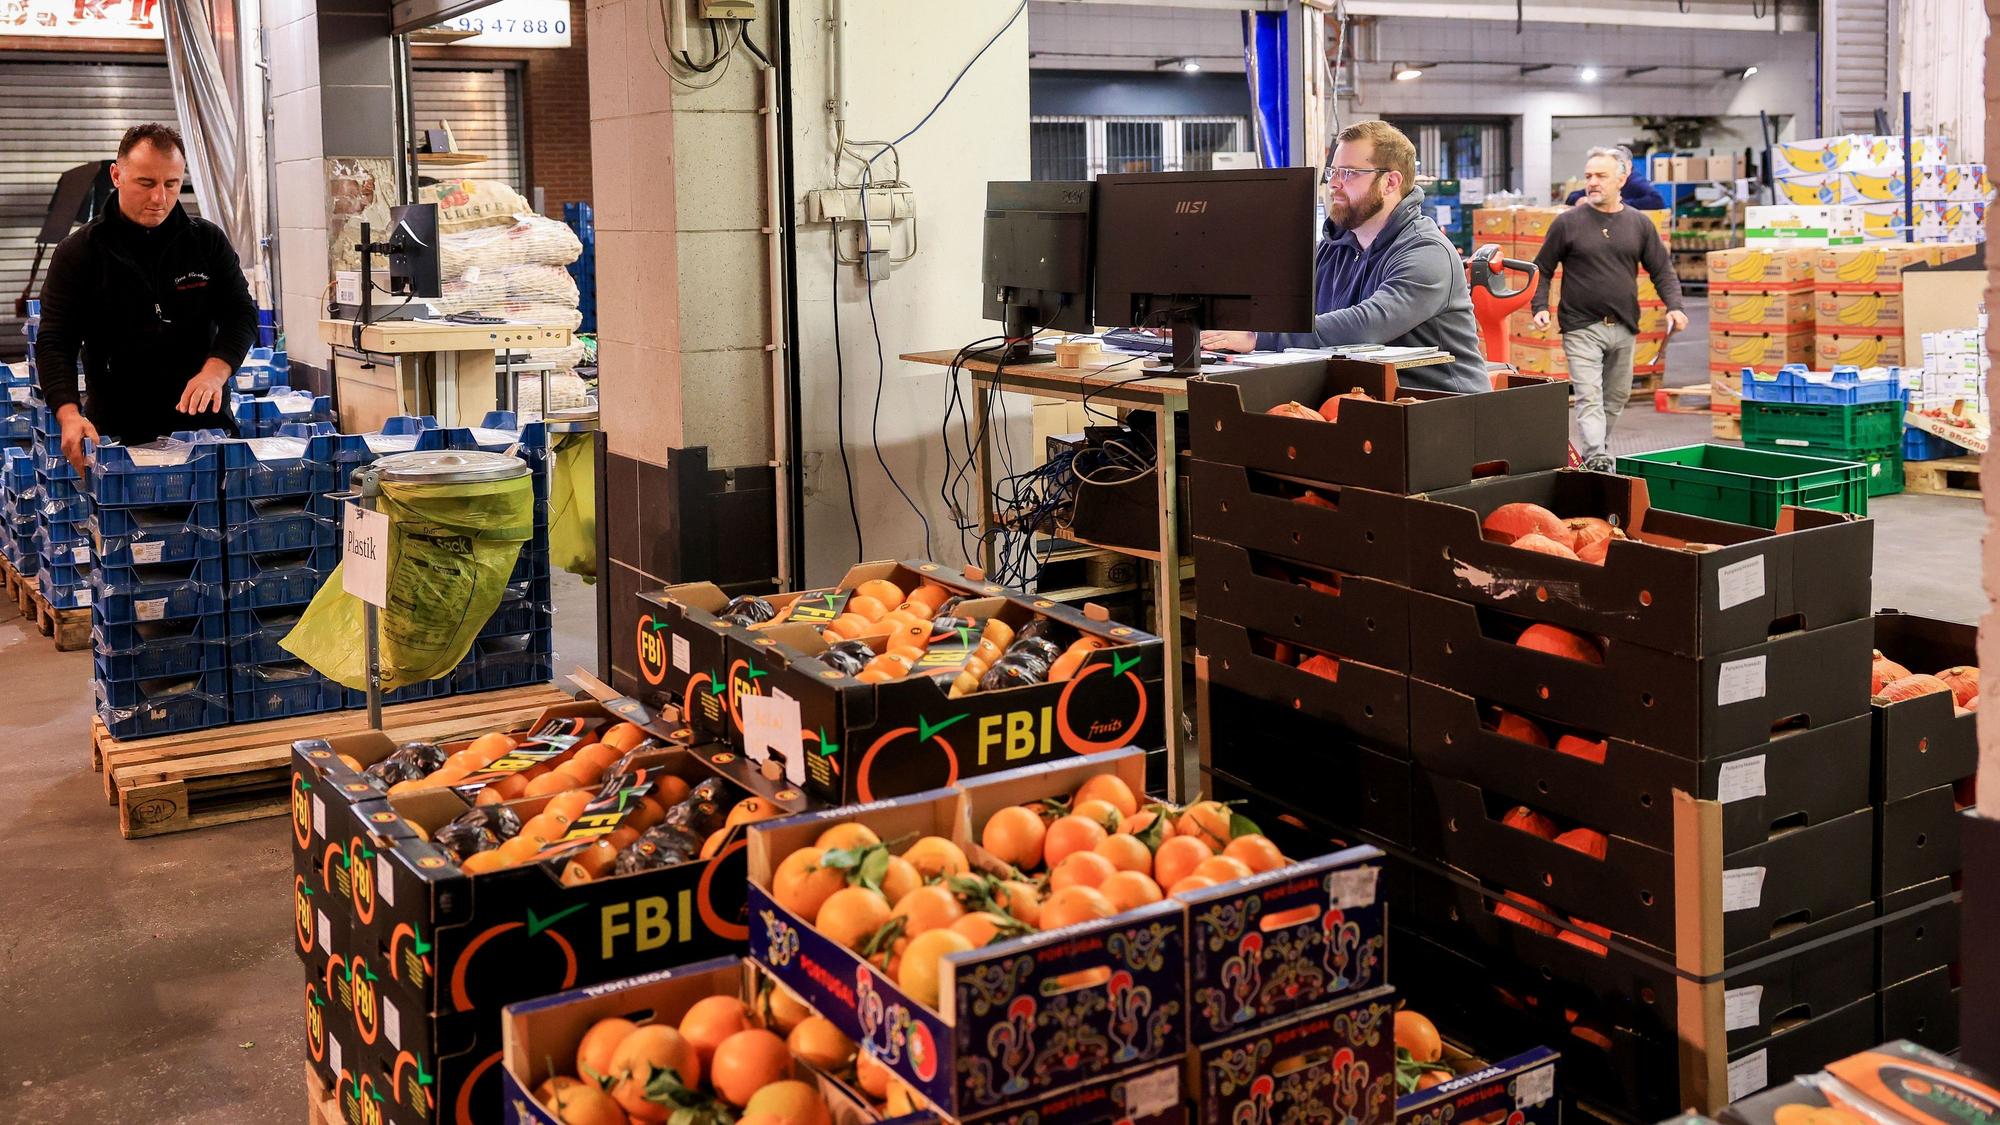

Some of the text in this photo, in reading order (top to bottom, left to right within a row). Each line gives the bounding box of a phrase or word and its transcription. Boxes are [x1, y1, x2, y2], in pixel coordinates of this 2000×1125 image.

[523, 20, 548, 33] 88
[555, 20, 566, 33] 0
[1175, 201, 1207, 213] MSI
[1949, 431, 1986, 451] ancona
[348, 530, 377, 560] Plastik
[436, 537, 469, 553] Sack
[641, 630, 661, 667] FBI
[978, 706, 1053, 766] FBI
[1088, 719, 1122, 739] fruits
[295, 789, 308, 830] FBI
[354, 855, 370, 904] FBI
[298, 891, 310, 934] FBI
[601, 889, 692, 960] FBI
[356, 974, 373, 1024] FBI
[582, 970, 672, 997] PORTUGAL
[801, 954, 855, 1009] PORTUGAL
[308, 999, 320, 1044] FBI
[1437, 1066, 1506, 1093] PORTUGAL
